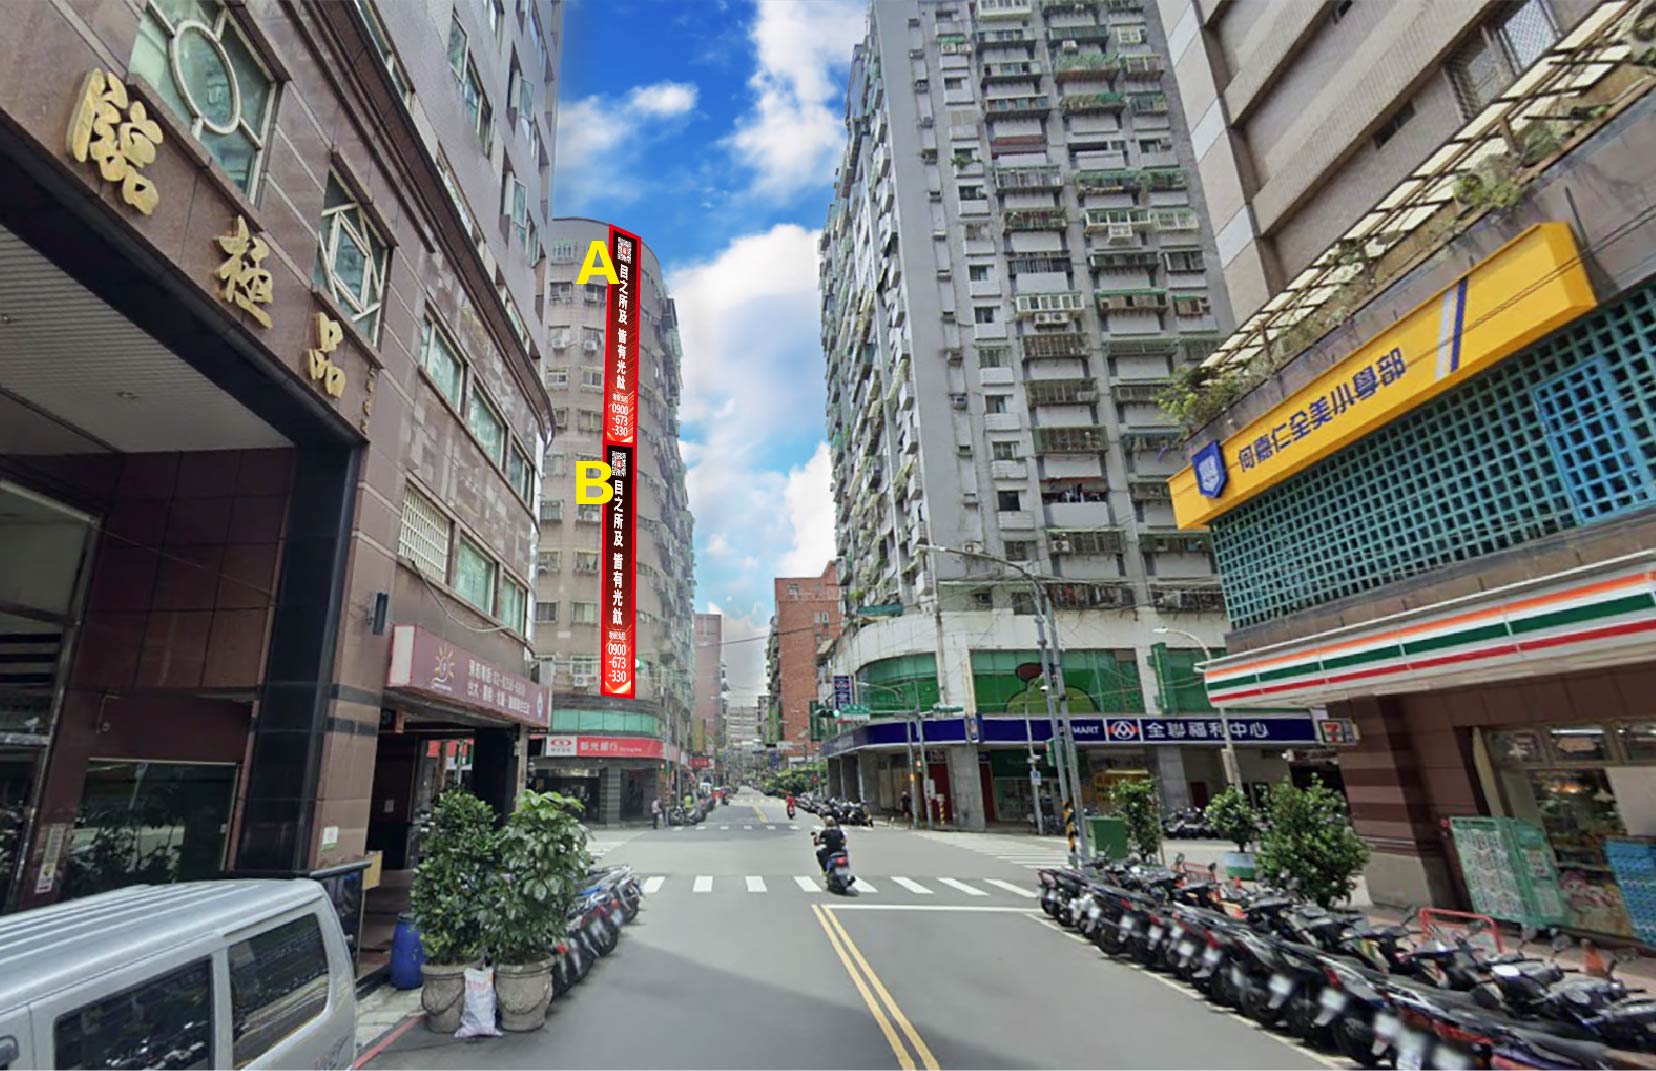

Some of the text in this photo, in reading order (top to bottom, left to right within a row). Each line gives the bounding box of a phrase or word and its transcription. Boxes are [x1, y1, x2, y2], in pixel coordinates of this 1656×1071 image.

[618, 264, 628, 325] 目之所及
[612, 403, 629, 416] 0900
[612, 415, 629, 427] -673
[611, 426, 628, 436] -330
[613, 480, 623, 546] 目之所及
[608, 643, 627, 656] 0900
[608, 656, 627, 670] -673
[608, 670, 627, 683] -330
